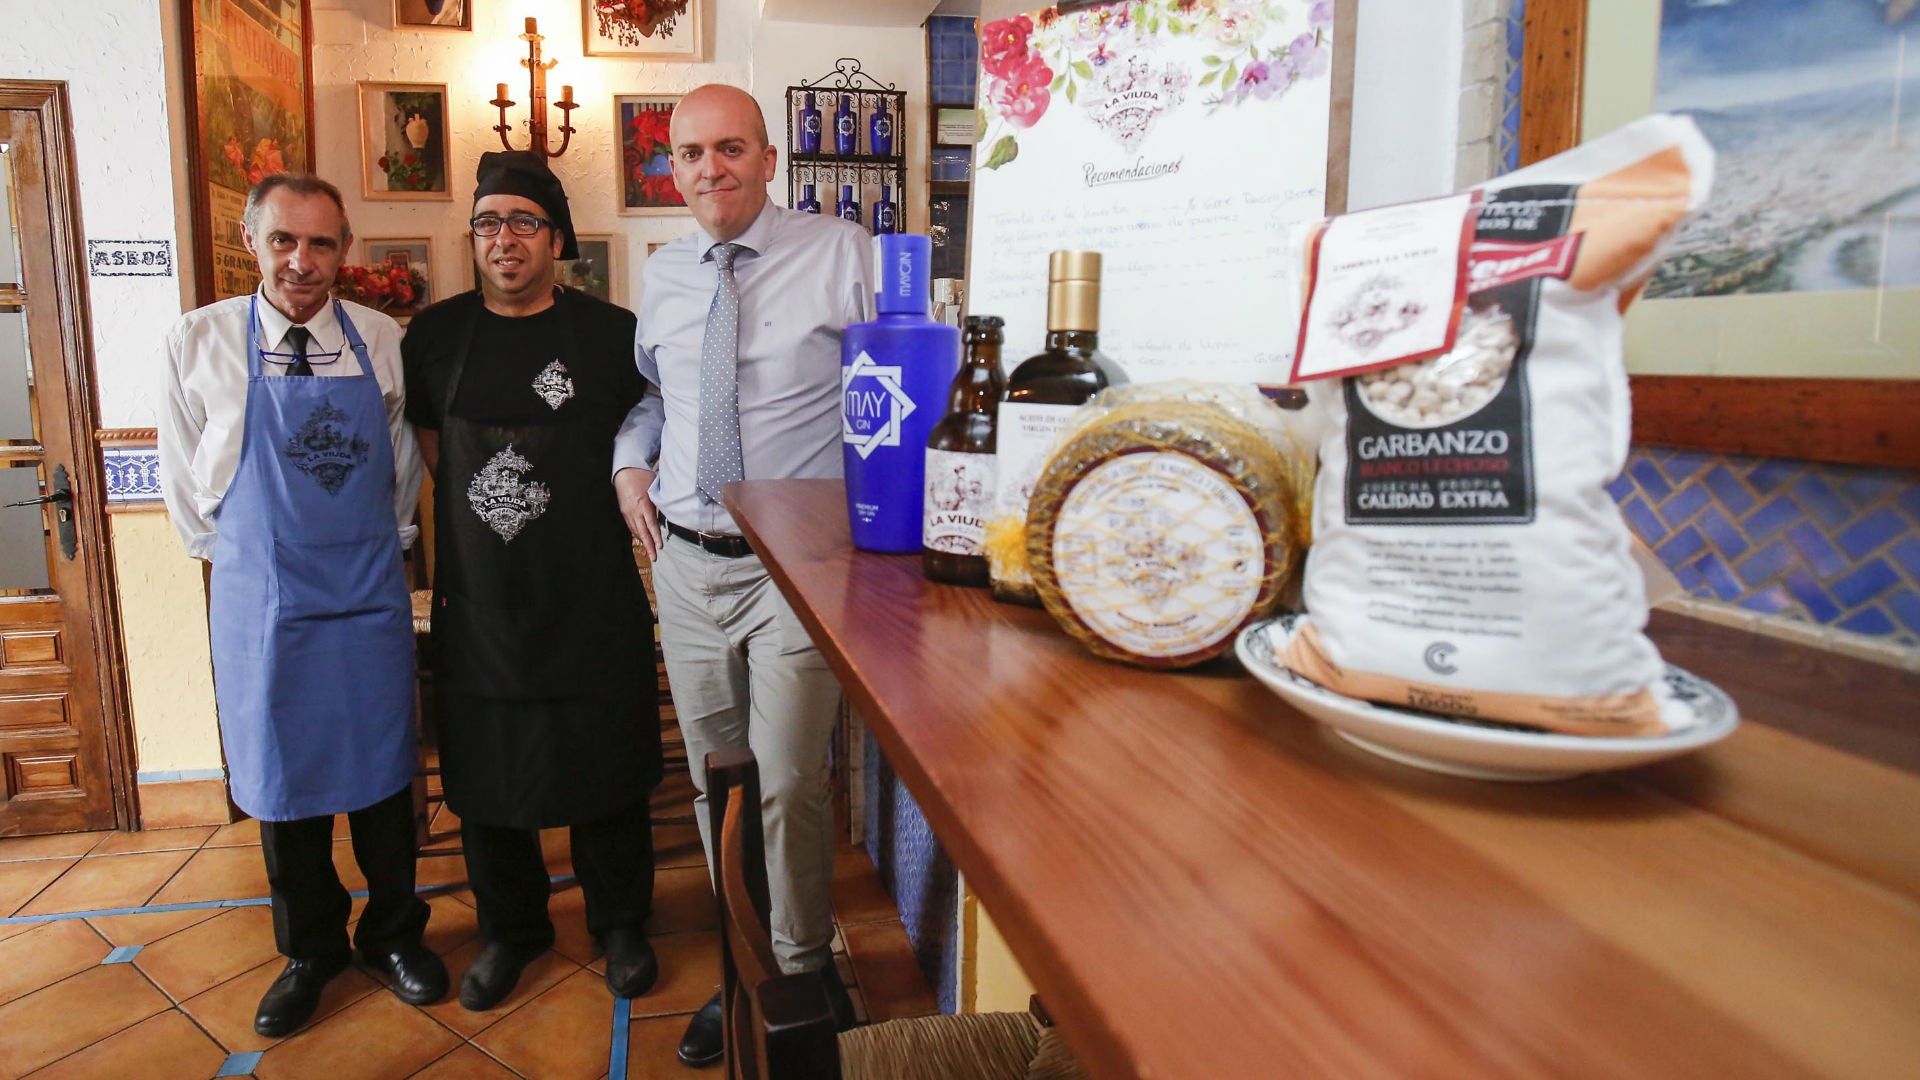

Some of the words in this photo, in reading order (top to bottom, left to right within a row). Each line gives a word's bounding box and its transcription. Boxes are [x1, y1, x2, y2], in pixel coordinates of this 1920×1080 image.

[1105, 98, 1119, 109] LA
[1123, 91, 1158, 100] VIUDA
[1083, 156, 1183, 187] Recomendaciones
[94, 251, 167, 266] ASEOS
[224, 254, 260, 273] GRANDE
[847, 390, 886, 418] MAY
[856, 419, 871, 430] GIN
[1358, 430, 1509, 459] GARBANZO
[322, 451, 352, 459] VIUDA
[484, 498, 496, 506] LA
[497, 496, 526, 507] VIUDA
[1358, 492, 1434, 509] CALIDAD
[1439, 490, 1511, 509] EXTRA
[930, 515, 944, 527] LA
[947, 514, 986, 529] VIUD
